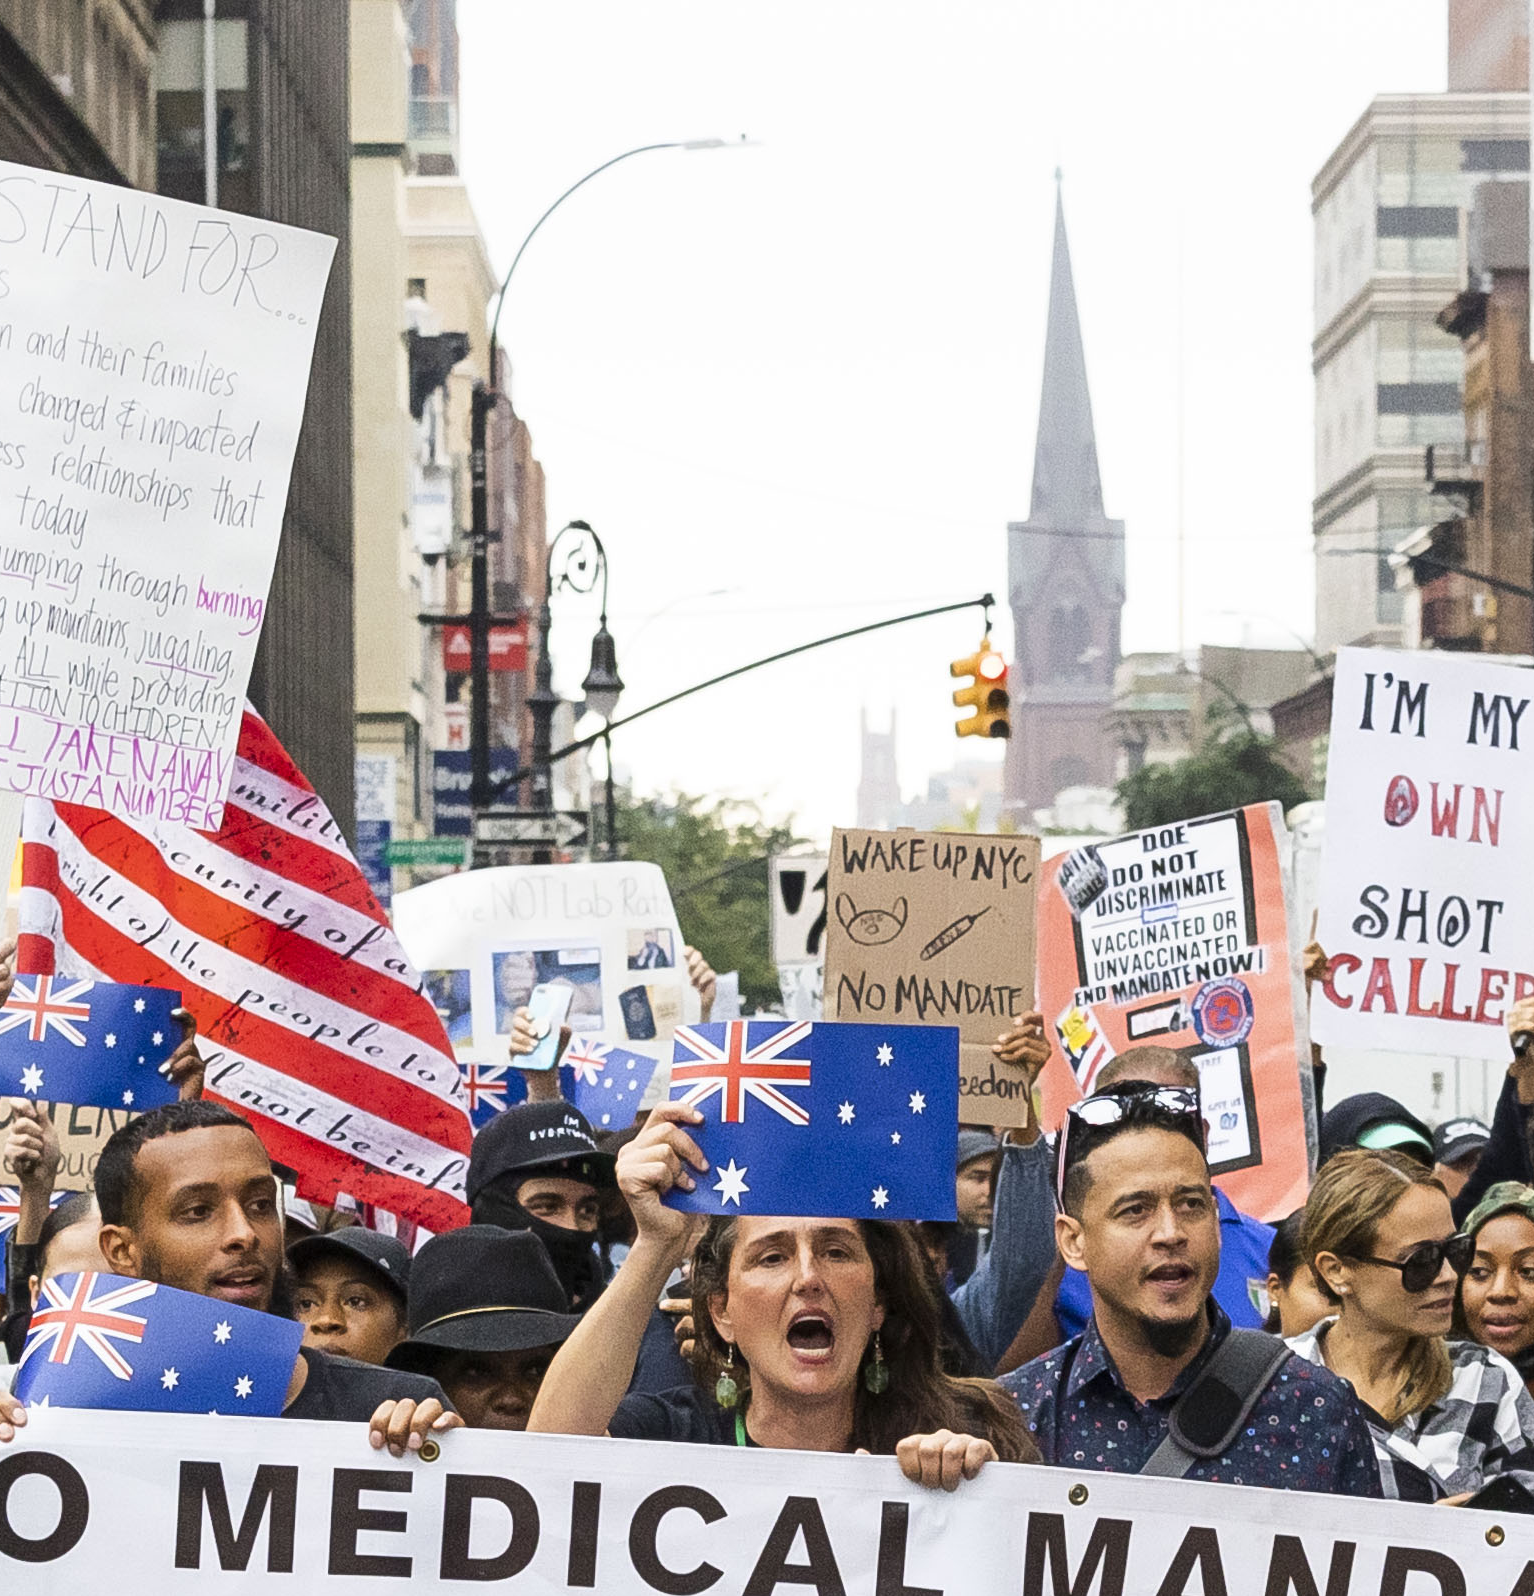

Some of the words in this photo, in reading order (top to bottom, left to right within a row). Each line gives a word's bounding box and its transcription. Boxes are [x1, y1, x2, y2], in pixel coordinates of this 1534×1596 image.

[27, 326, 68, 360] and
[79, 328, 136, 376] their
[141, 340, 240, 399] families
[18, 378, 109, 444] changed
[139, 408, 261, 463] impacted
[51, 443, 193, 523] relationships
[209, 475, 266, 529] that
[15, 484, 89, 550] today
[15, 600, 43, 637] up
[96, 553, 188, 618] through
[196, 574, 266, 637] burning
[15, 635, 61, 679] ALL
[67, 655, 120, 698] while
[78, 691, 100, 727] TO
[1358, 671, 1430, 738] I'M
[1465, 690, 1530, 751] MY
[43, 717, 162, 784] TAKEN
[157, 745, 234, 804] AWAY
[8, 762, 91, 804] JUST
[82, 774, 105, 810] A
[112, 778, 227, 832] NUMBER
[1382, 773, 1506, 848] OWN
[841, 834, 927, 875] WAKE
[932, 839, 968, 886] UP
[970, 844, 1034, 890] NYC
[1141, 825, 1189, 853] DOE
[490, 876, 557, 921] NOT
[561, 880, 614, 919] Lab
[1094, 869, 1228, 918] DISCRIMINATE
[1111, 866, 1143, 888] DO
[1151, 850, 1200, 878] NOT
[323, 924, 387, 962] of
[1090, 917, 1206, 959] VACCINATED
[1212, 909, 1238, 932] OR
[1351, 883, 1505, 954] SHOT
[1074, 985, 1108, 1007] END
[1110, 967, 1194, 1005] MANDATE
[1093, 933, 1239, 982] UNVACCINATED
[835, 970, 887, 1018] NO
[894, 973, 1025, 1021] MANDATE
[237, 988, 385, 1059] people
[400, 1053, 437, 1083] to
[958, 1063, 1029, 1103] eedom
[239, 1089, 316, 1127] not
[325, 1114, 372, 1153] be
